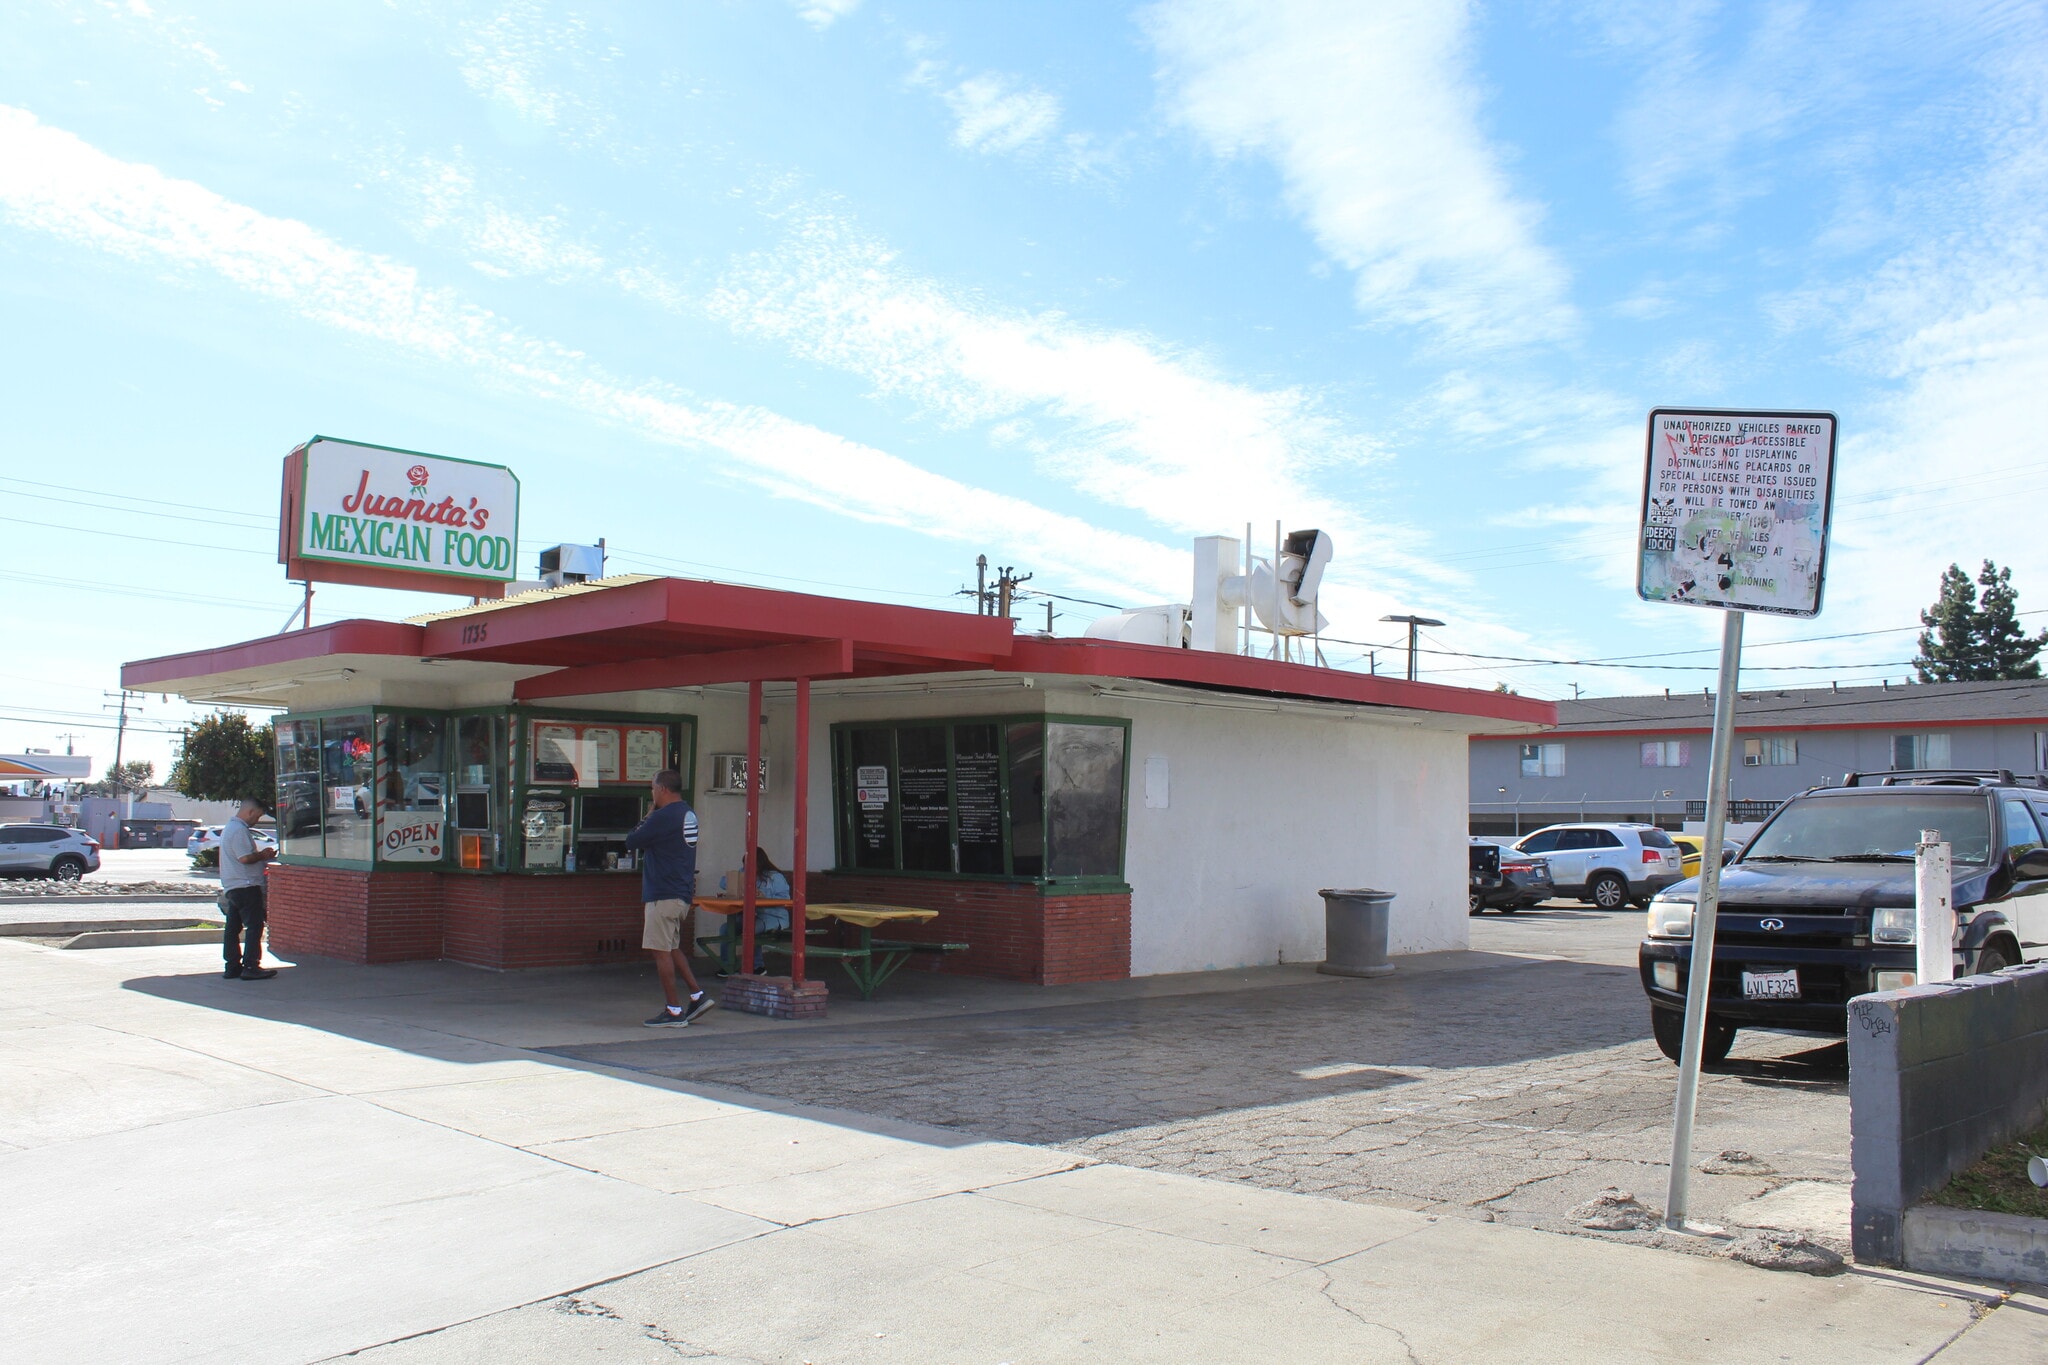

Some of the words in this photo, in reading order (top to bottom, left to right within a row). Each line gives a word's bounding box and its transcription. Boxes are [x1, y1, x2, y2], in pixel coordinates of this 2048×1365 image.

[1663, 420, 1732, 432] UNAUTHORIZED
[1738, 423, 1780, 434] VEHICLES
[1786, 424, 1821, 434] PARKED
[1676, 434, 1685, 443] IN
[1692, 434, 1746, 446] DESIGNATED
[1752, 436, 1806, 448] ACCESSIBLE
[1722, 448, 1739, 458] NOT
[1745, 448, 1798, 460] DISPLAYING
[1668, 458, 1740, 470] DISTINGUISHING
[1746, 462, 1792, 472] PLACARDS
[1798, 464, 1811, 474] OR
[1660, 470, 1696, 481] SPECIAL
[1702, 472, 1740, 483] LICENSE
[1746, 474, 1777, 485] PLATES
[1784, 476, 1816, 487] ISSUED
[1660, 482, 1676, 492] FOR
[1682, 484, 1724, 495] PERSONS
[1730, 486, 1750, 496] WITH
[1756, 488, 1815, 500] DISABILITIES
[342, 470, 489, 530] Juanita's
[1684, 496, 1705, 506] WILL
[1730, 499, 1758, 510] TOWED
[1672, 508, 1682, 517] AT
[1646, 526, 1676, 540] !DEEPS!
[310, 512, 432, 562] MEXICAN
[444, 529, 511, 572] FOOD
[1648, 539, 1672, 551] !DCK!
[1774, 546, 1783, 556] AT
[462, 622, 488, 646] 1735
[386, 822, 440, 849] OPEN
